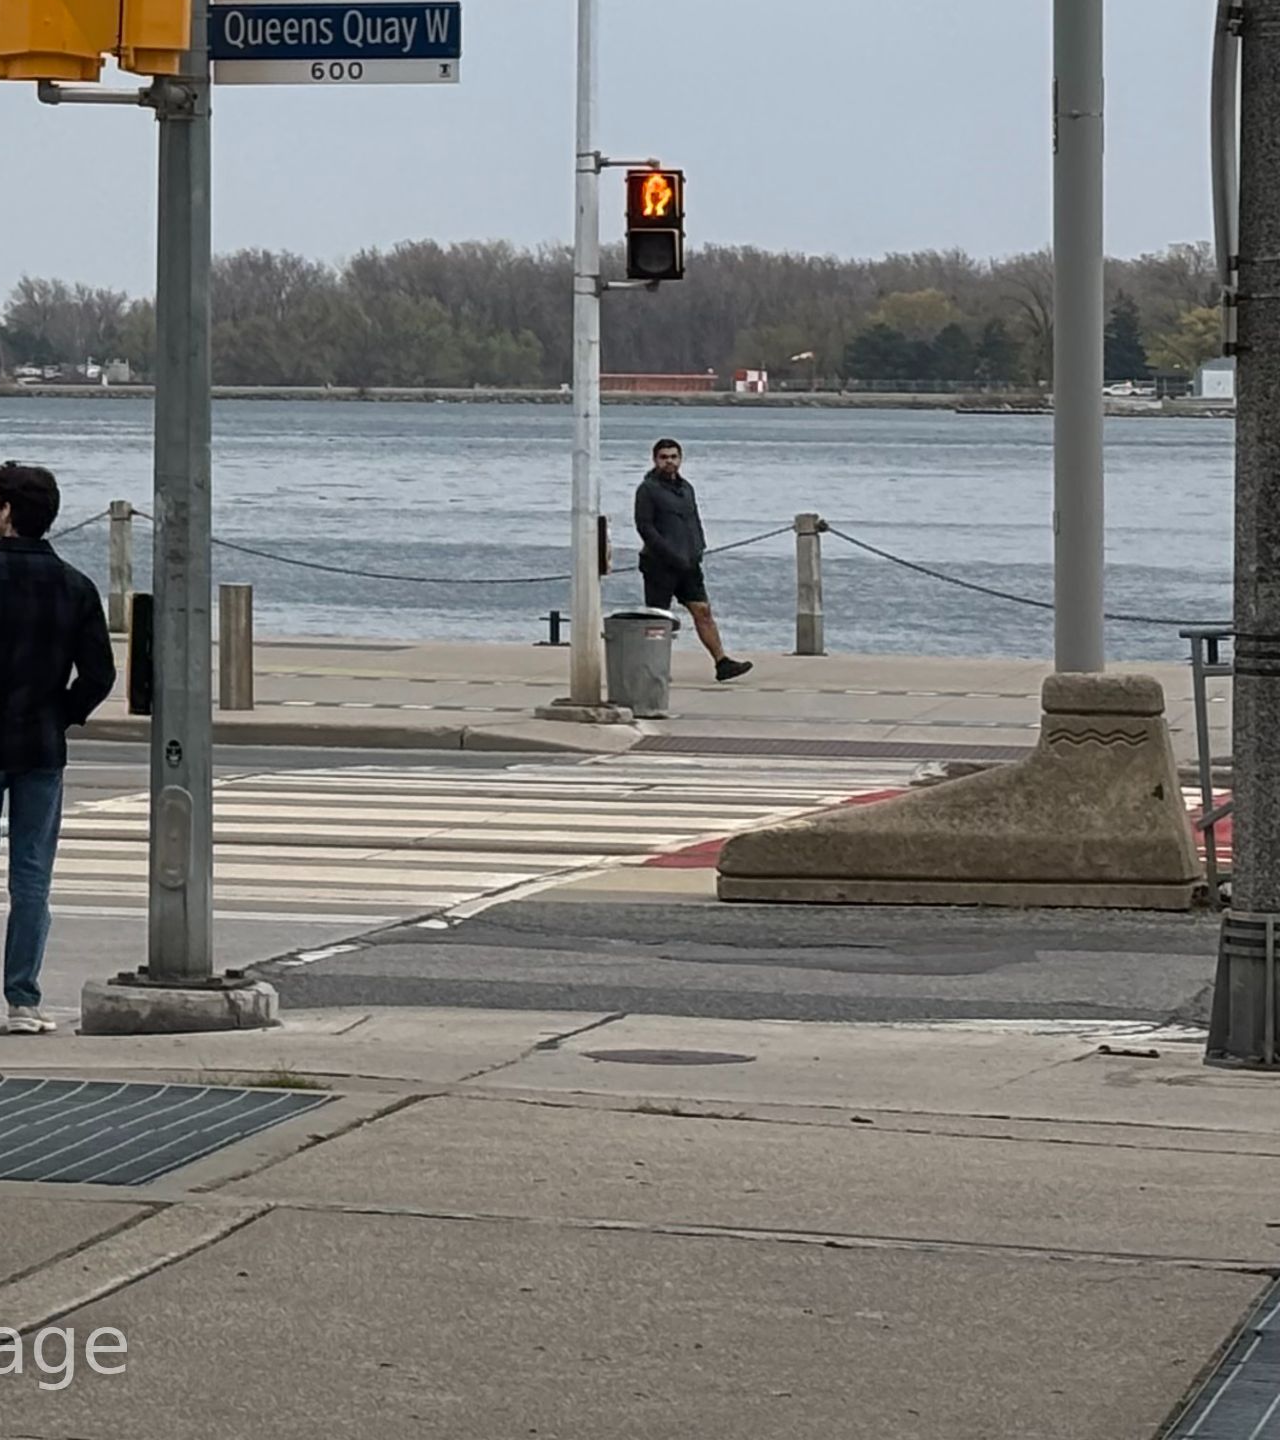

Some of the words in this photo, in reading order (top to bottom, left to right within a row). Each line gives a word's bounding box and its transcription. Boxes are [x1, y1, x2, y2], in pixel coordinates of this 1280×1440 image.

[224, 11, 334, 48] Queens
[343, 10, 418, 53] Quay
[425, 9, 450, 43] W
[311, 62, 364, 80] 600
